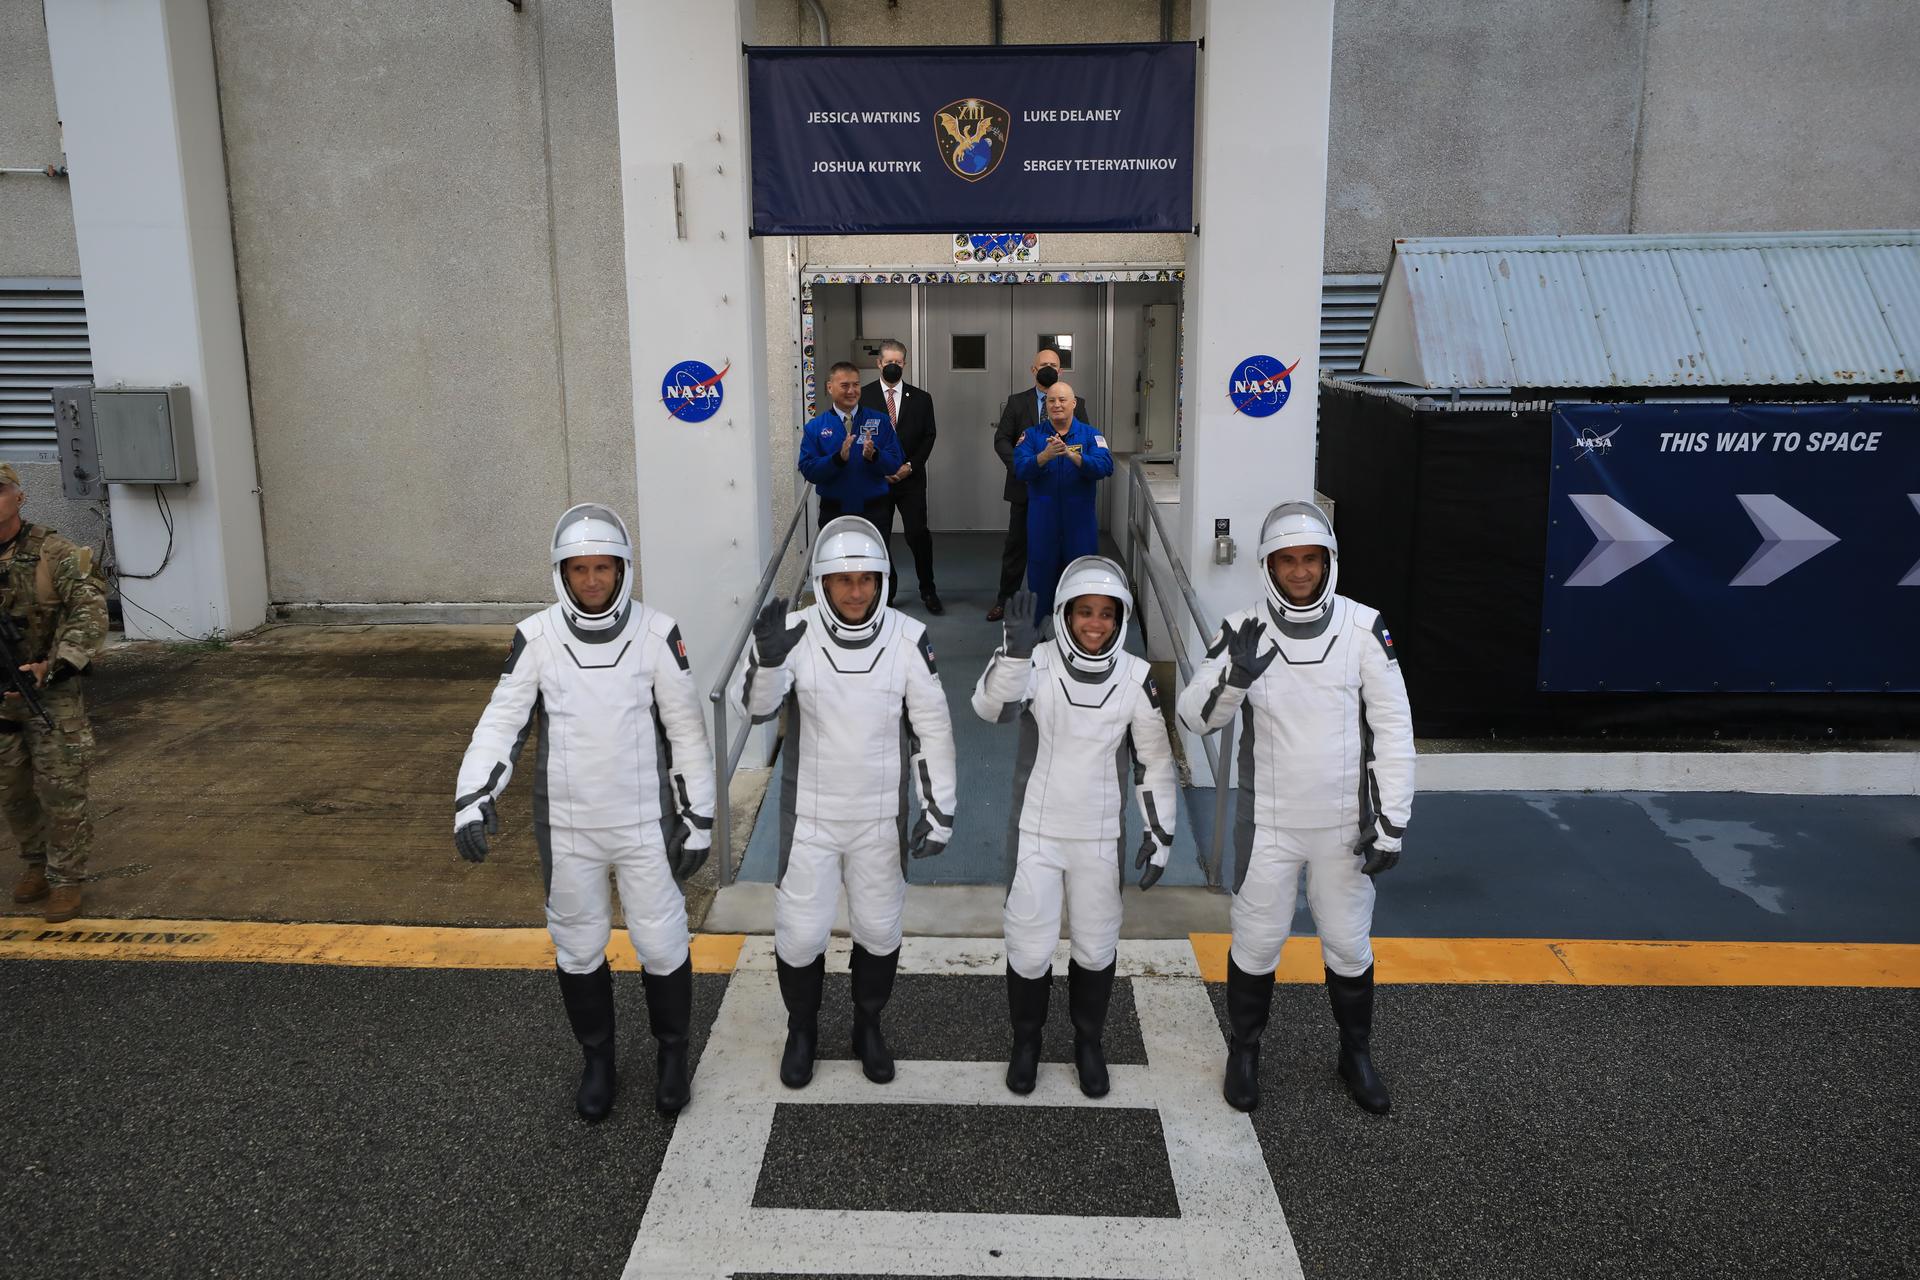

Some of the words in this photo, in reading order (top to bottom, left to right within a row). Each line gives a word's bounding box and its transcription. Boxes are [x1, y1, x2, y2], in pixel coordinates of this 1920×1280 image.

[807, 111, 859, 124] JESSICA
[861, 111, 921, 124] WATKINS
[1023, 110, 1057, 122] LUKE
[1060, 109, 1122, 122] DELANEY
[812, 161, 865, 173] JOSHUA
[869, 161, 922, 173] KUTRYK
[1023, 159, 1072, 171] SERGEY
[1074, 158, 1177, 171] TETERYATNIKOV
[667, 385, 720, 398] NASA
[1234, 380, 1288, 393] NASA
[1576, 438, 1613, 448] NASA
[1659, 432, 1710, 453] THIS
[1716, 432, 1767, 453] WAY
[1771, 432, 1801, 453] TO
[1805, 432, 1883, 452] SPACE
[32, 930, 208, 943] PARKING
